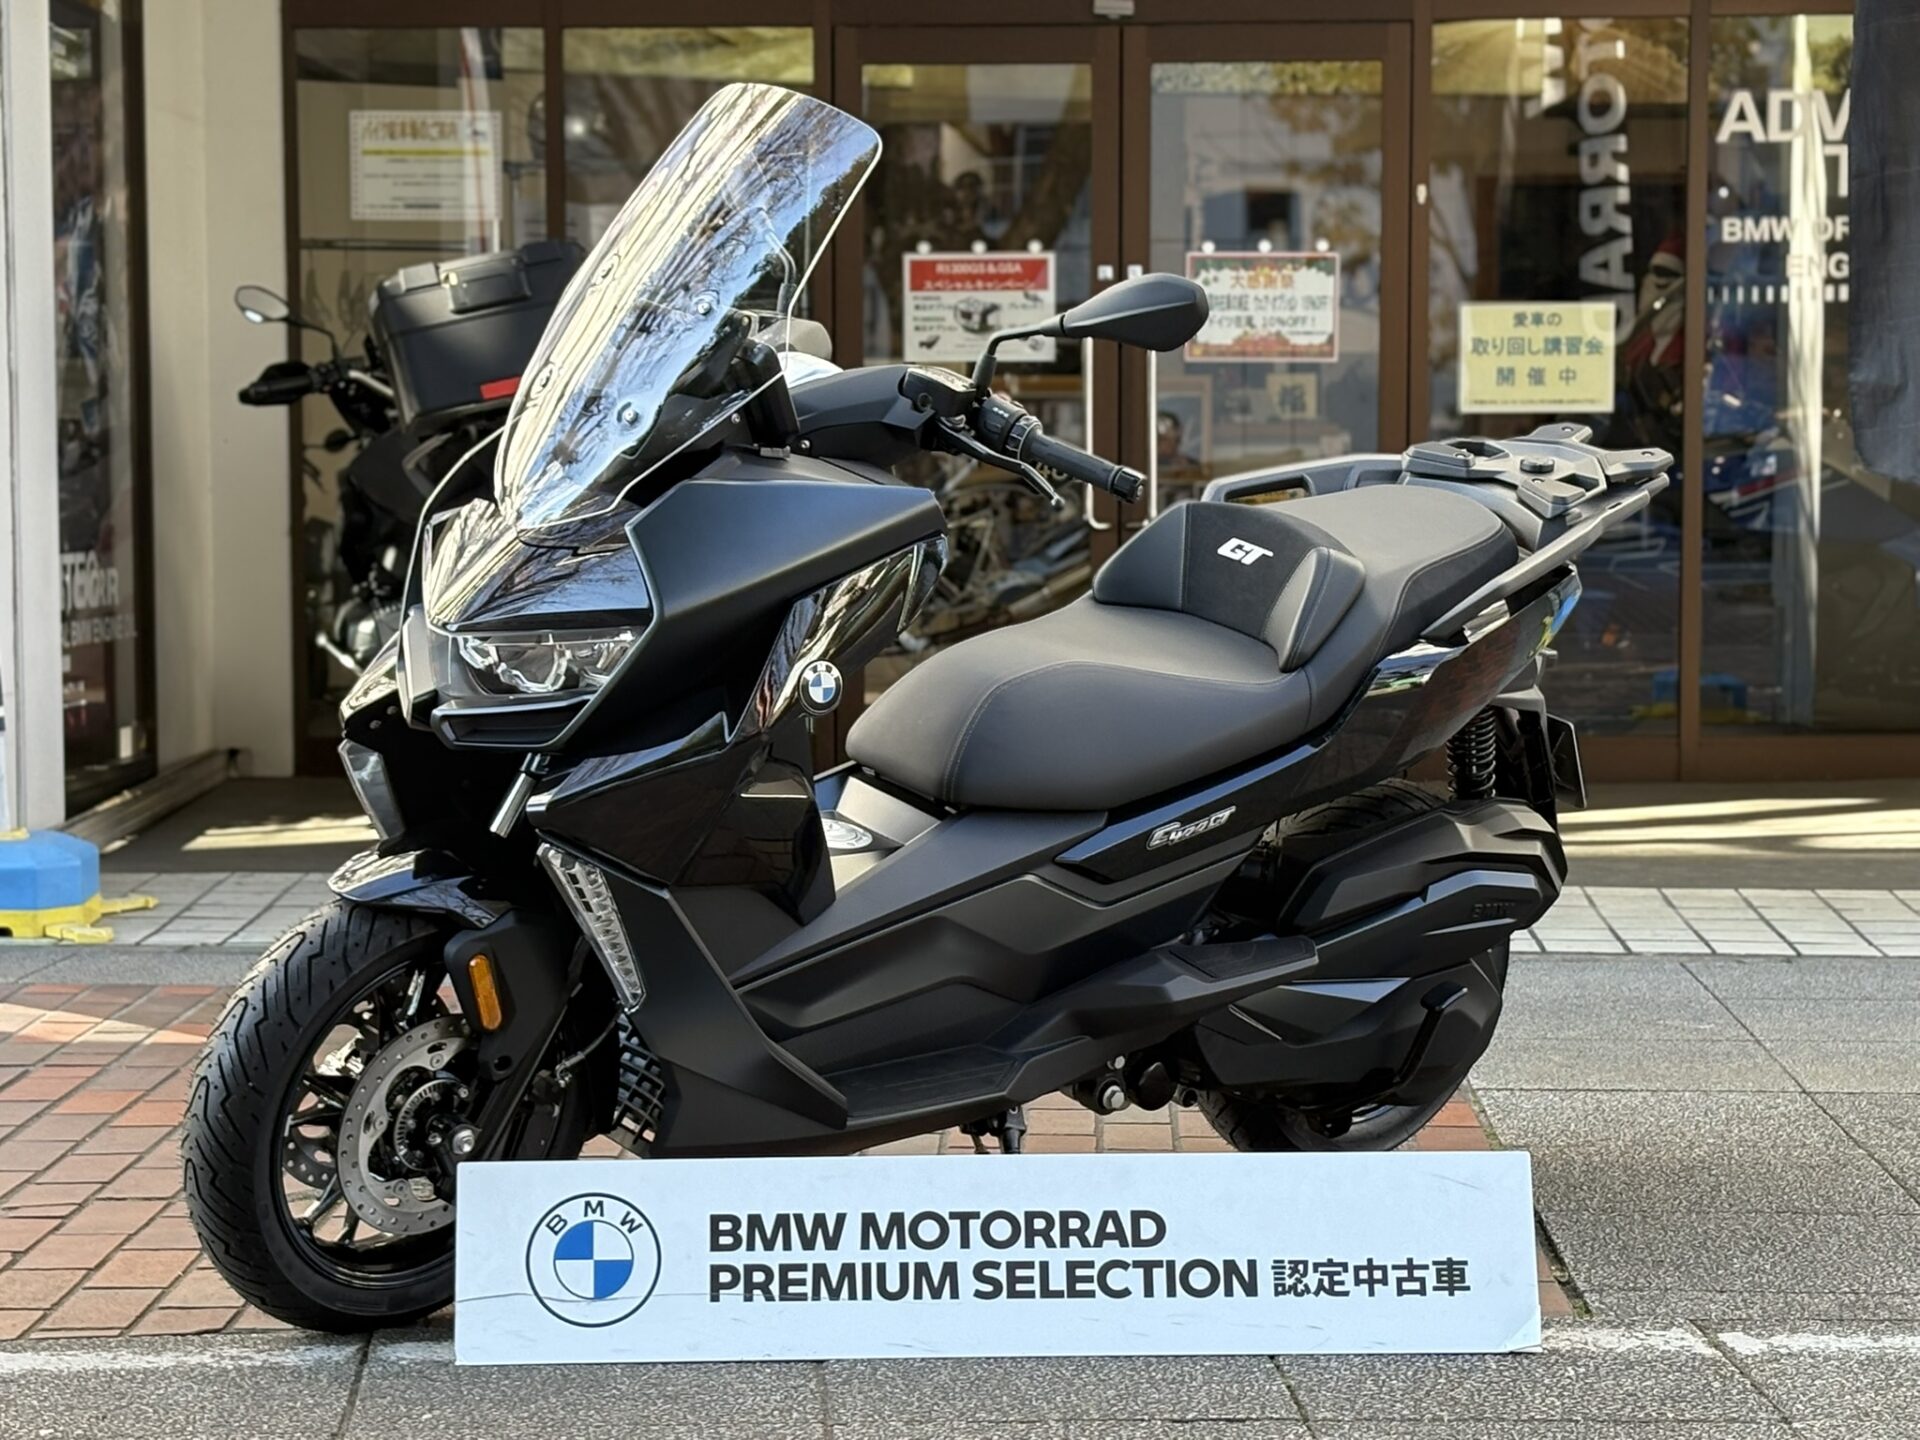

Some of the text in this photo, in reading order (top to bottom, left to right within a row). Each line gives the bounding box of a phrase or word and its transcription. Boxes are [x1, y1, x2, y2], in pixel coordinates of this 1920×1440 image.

[1513, 312, 1562, 328] 愛車の
[1471, 336, 1604, 356] 取り回し講習会
[1217, 537, 1274, 565] GT
[545, 1200, 643, 1236] BMW
[709, 1210, 1167, 1252] BMW MOTORRAD
[709, 1257, 1471, 1302] PREMIUM SELECTION 認定中古車
